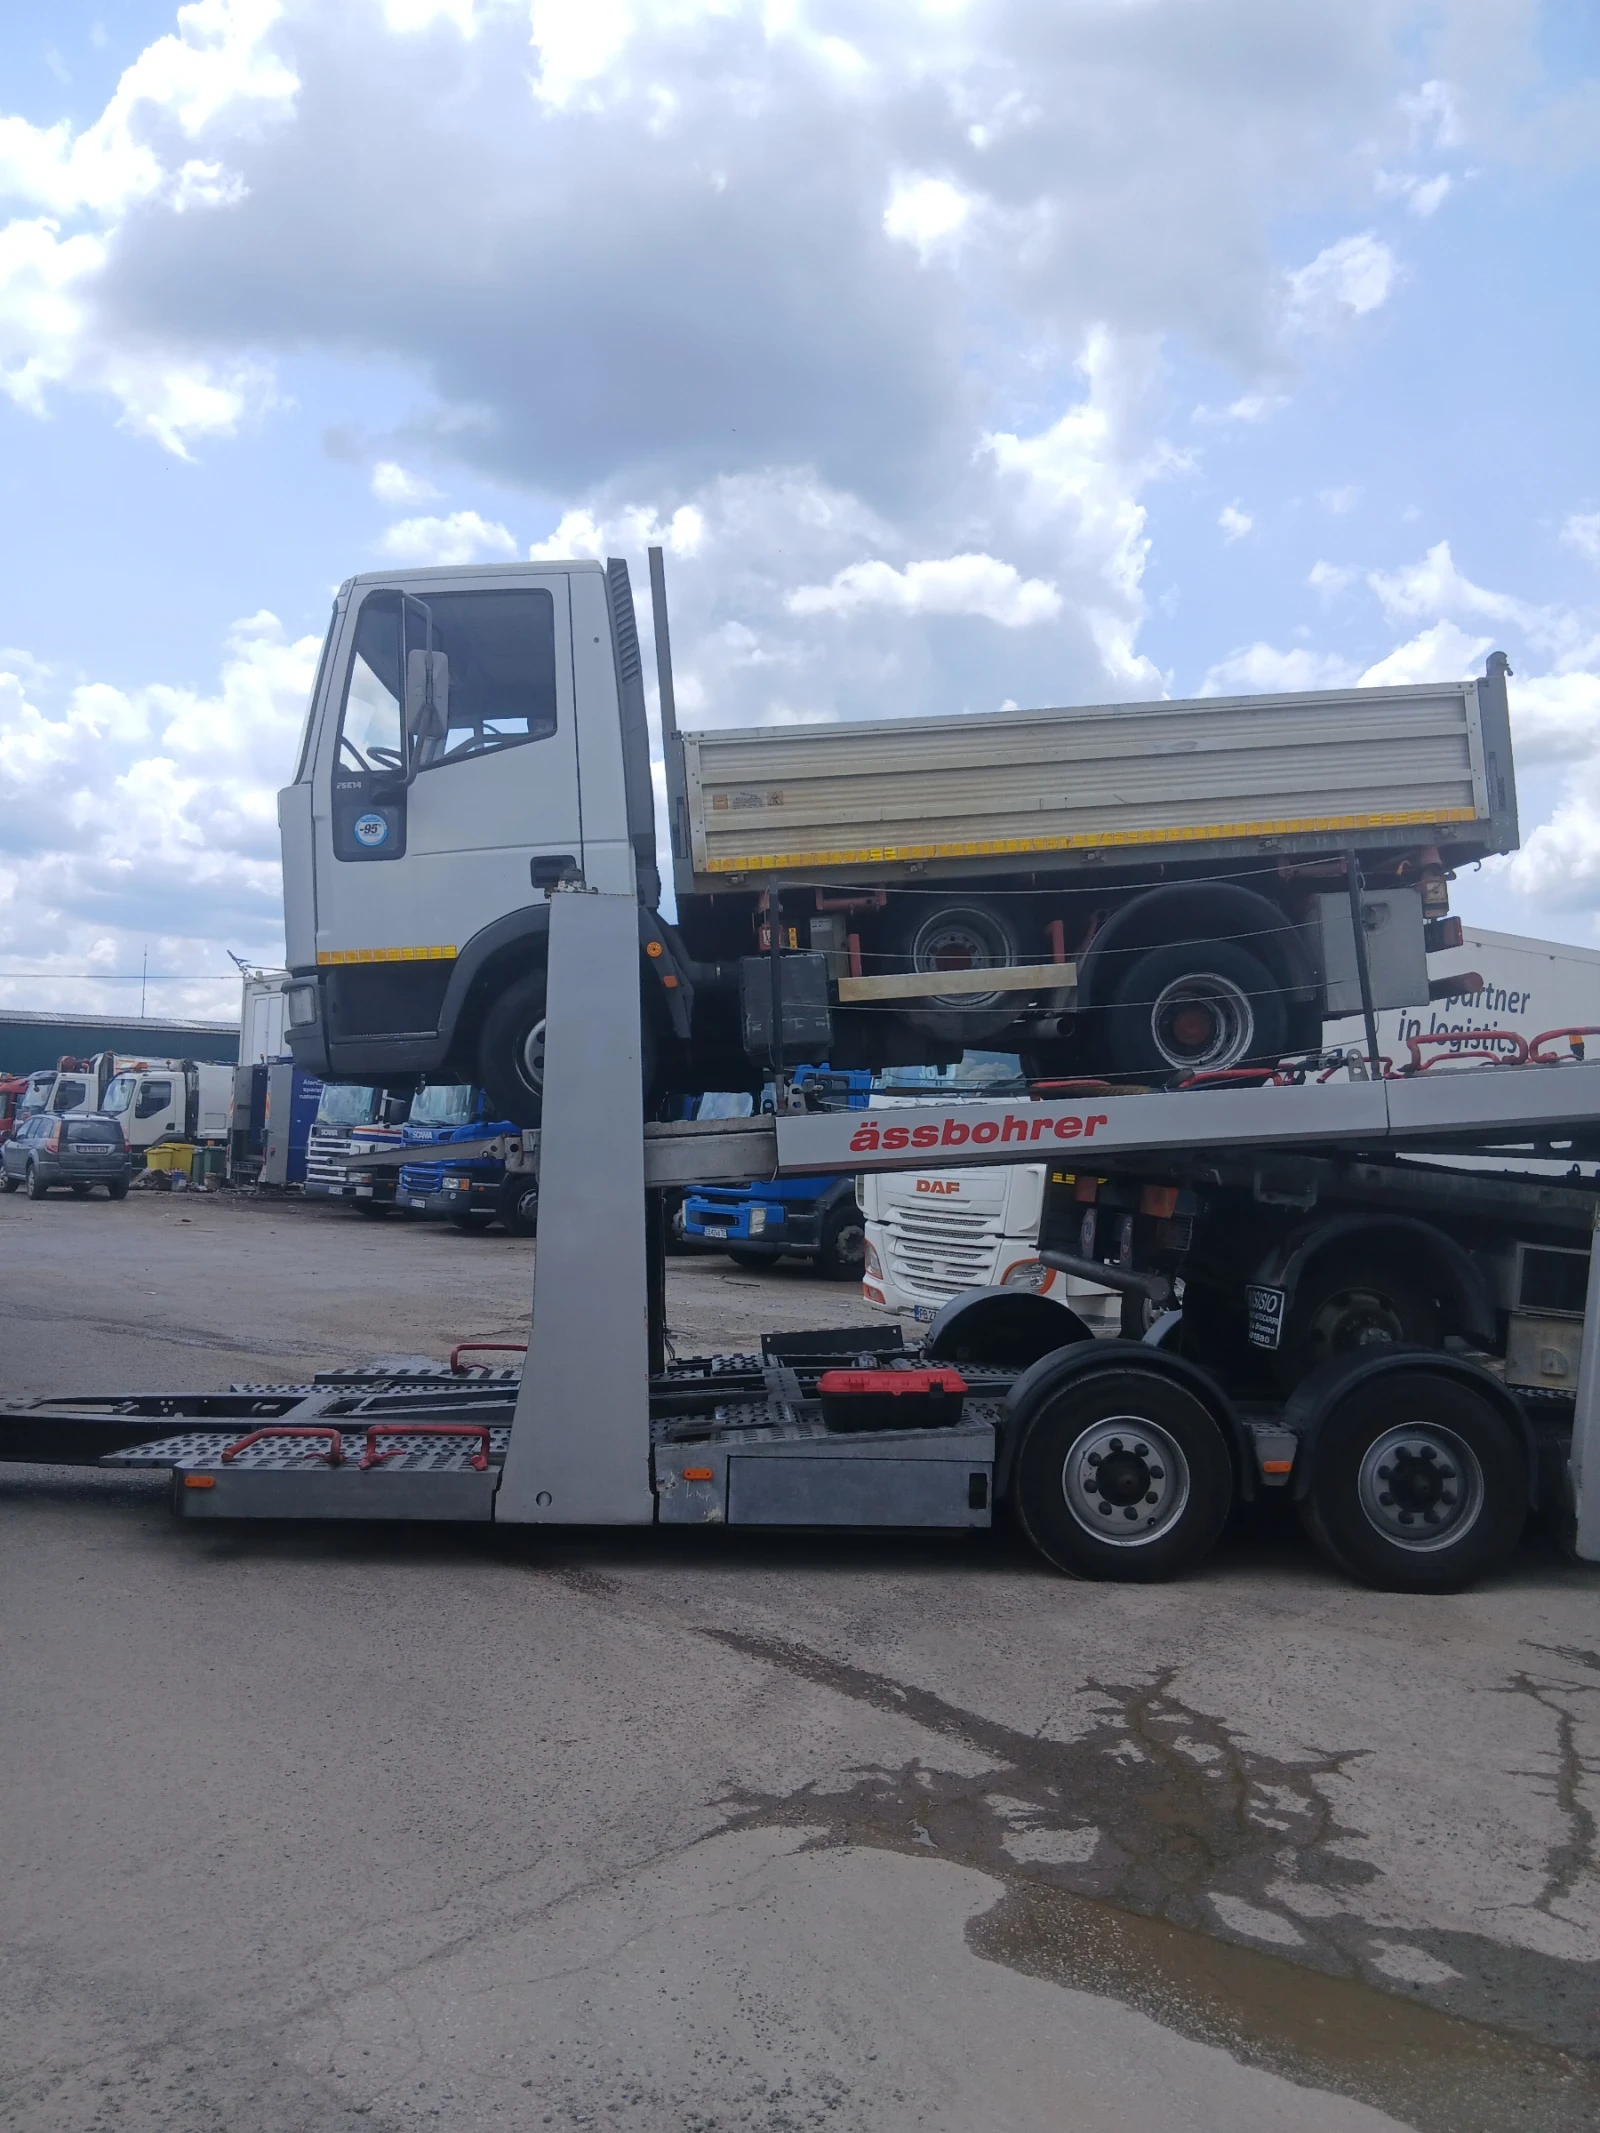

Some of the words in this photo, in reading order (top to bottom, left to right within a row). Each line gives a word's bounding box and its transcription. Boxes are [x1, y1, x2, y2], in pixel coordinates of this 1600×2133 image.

[1445, 982, 1531, 1015] partner
[1397, 1009, 1421, 1042] in
[1429, 1012, 1518, 1054] logistics
[320, 1128, 338, 1136] SCANIA
[411, 1130, 433, 1140] SCANIA
[849, 1114, 1108, 1152] ässbohrer
[915, 1179, 960, 1195] DAF
[919, 1308, 929, 1320] PB
[929, 1310, 938, 1321] 27
